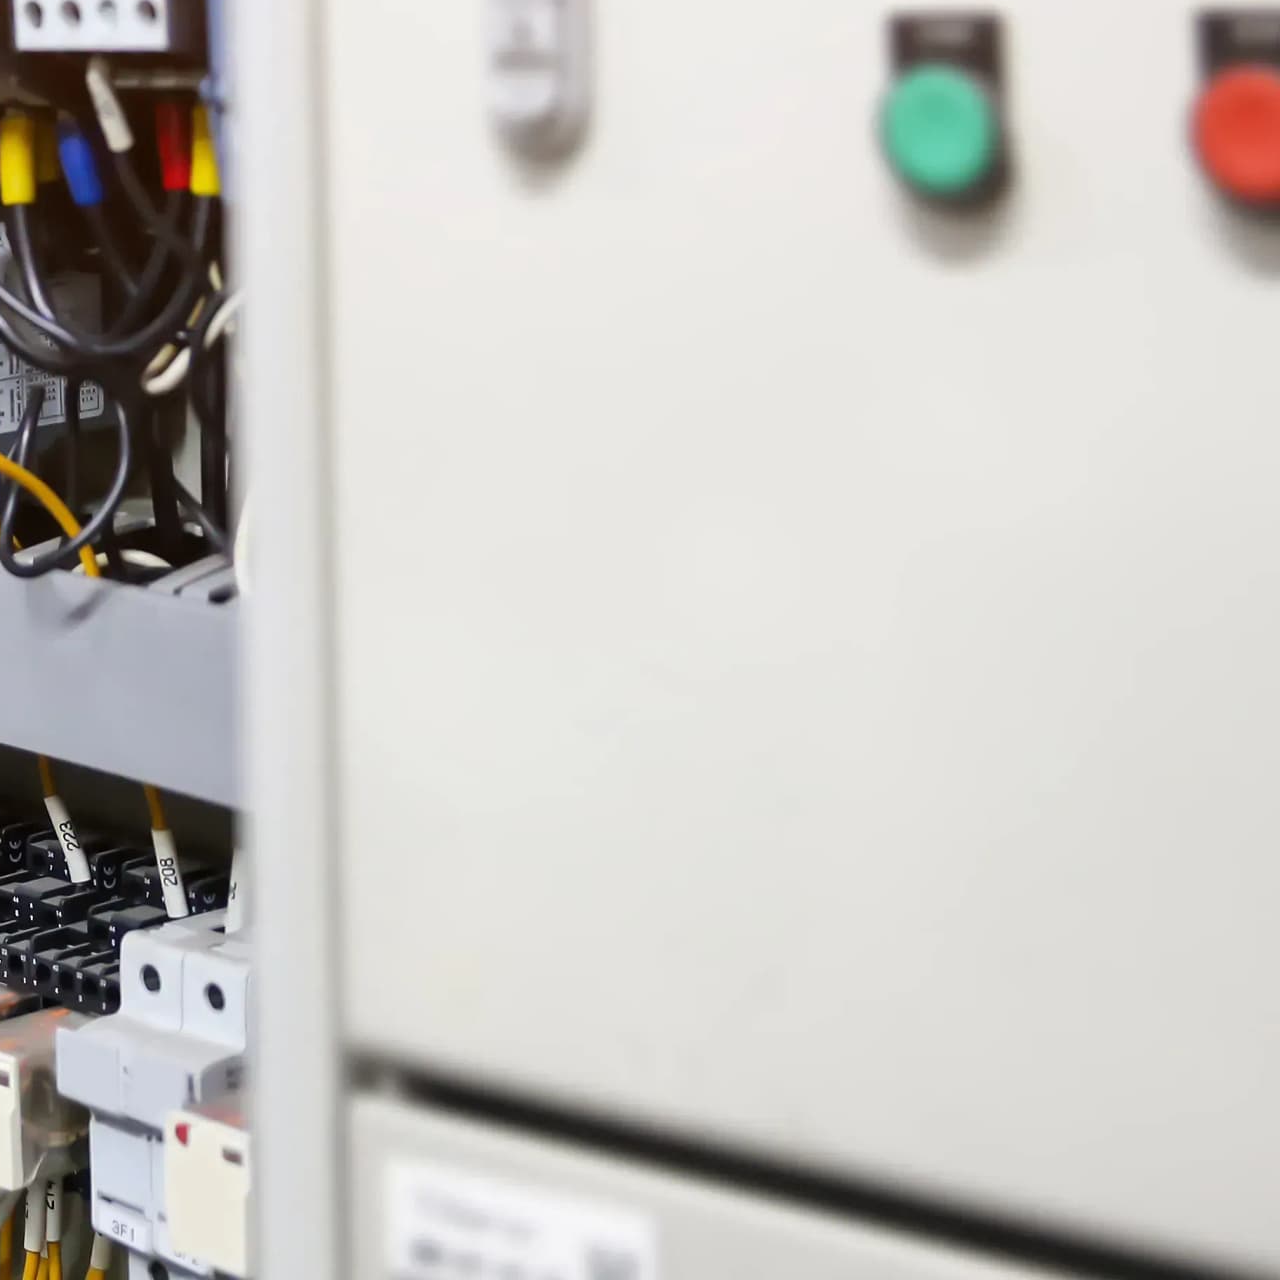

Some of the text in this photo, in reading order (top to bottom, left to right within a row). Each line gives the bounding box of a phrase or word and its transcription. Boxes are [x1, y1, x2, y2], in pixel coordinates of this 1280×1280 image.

[59, 820, 82, 852] 223
[159, 857, 179, 887] 208
[111, 1219, 136, 1243] 3F1
